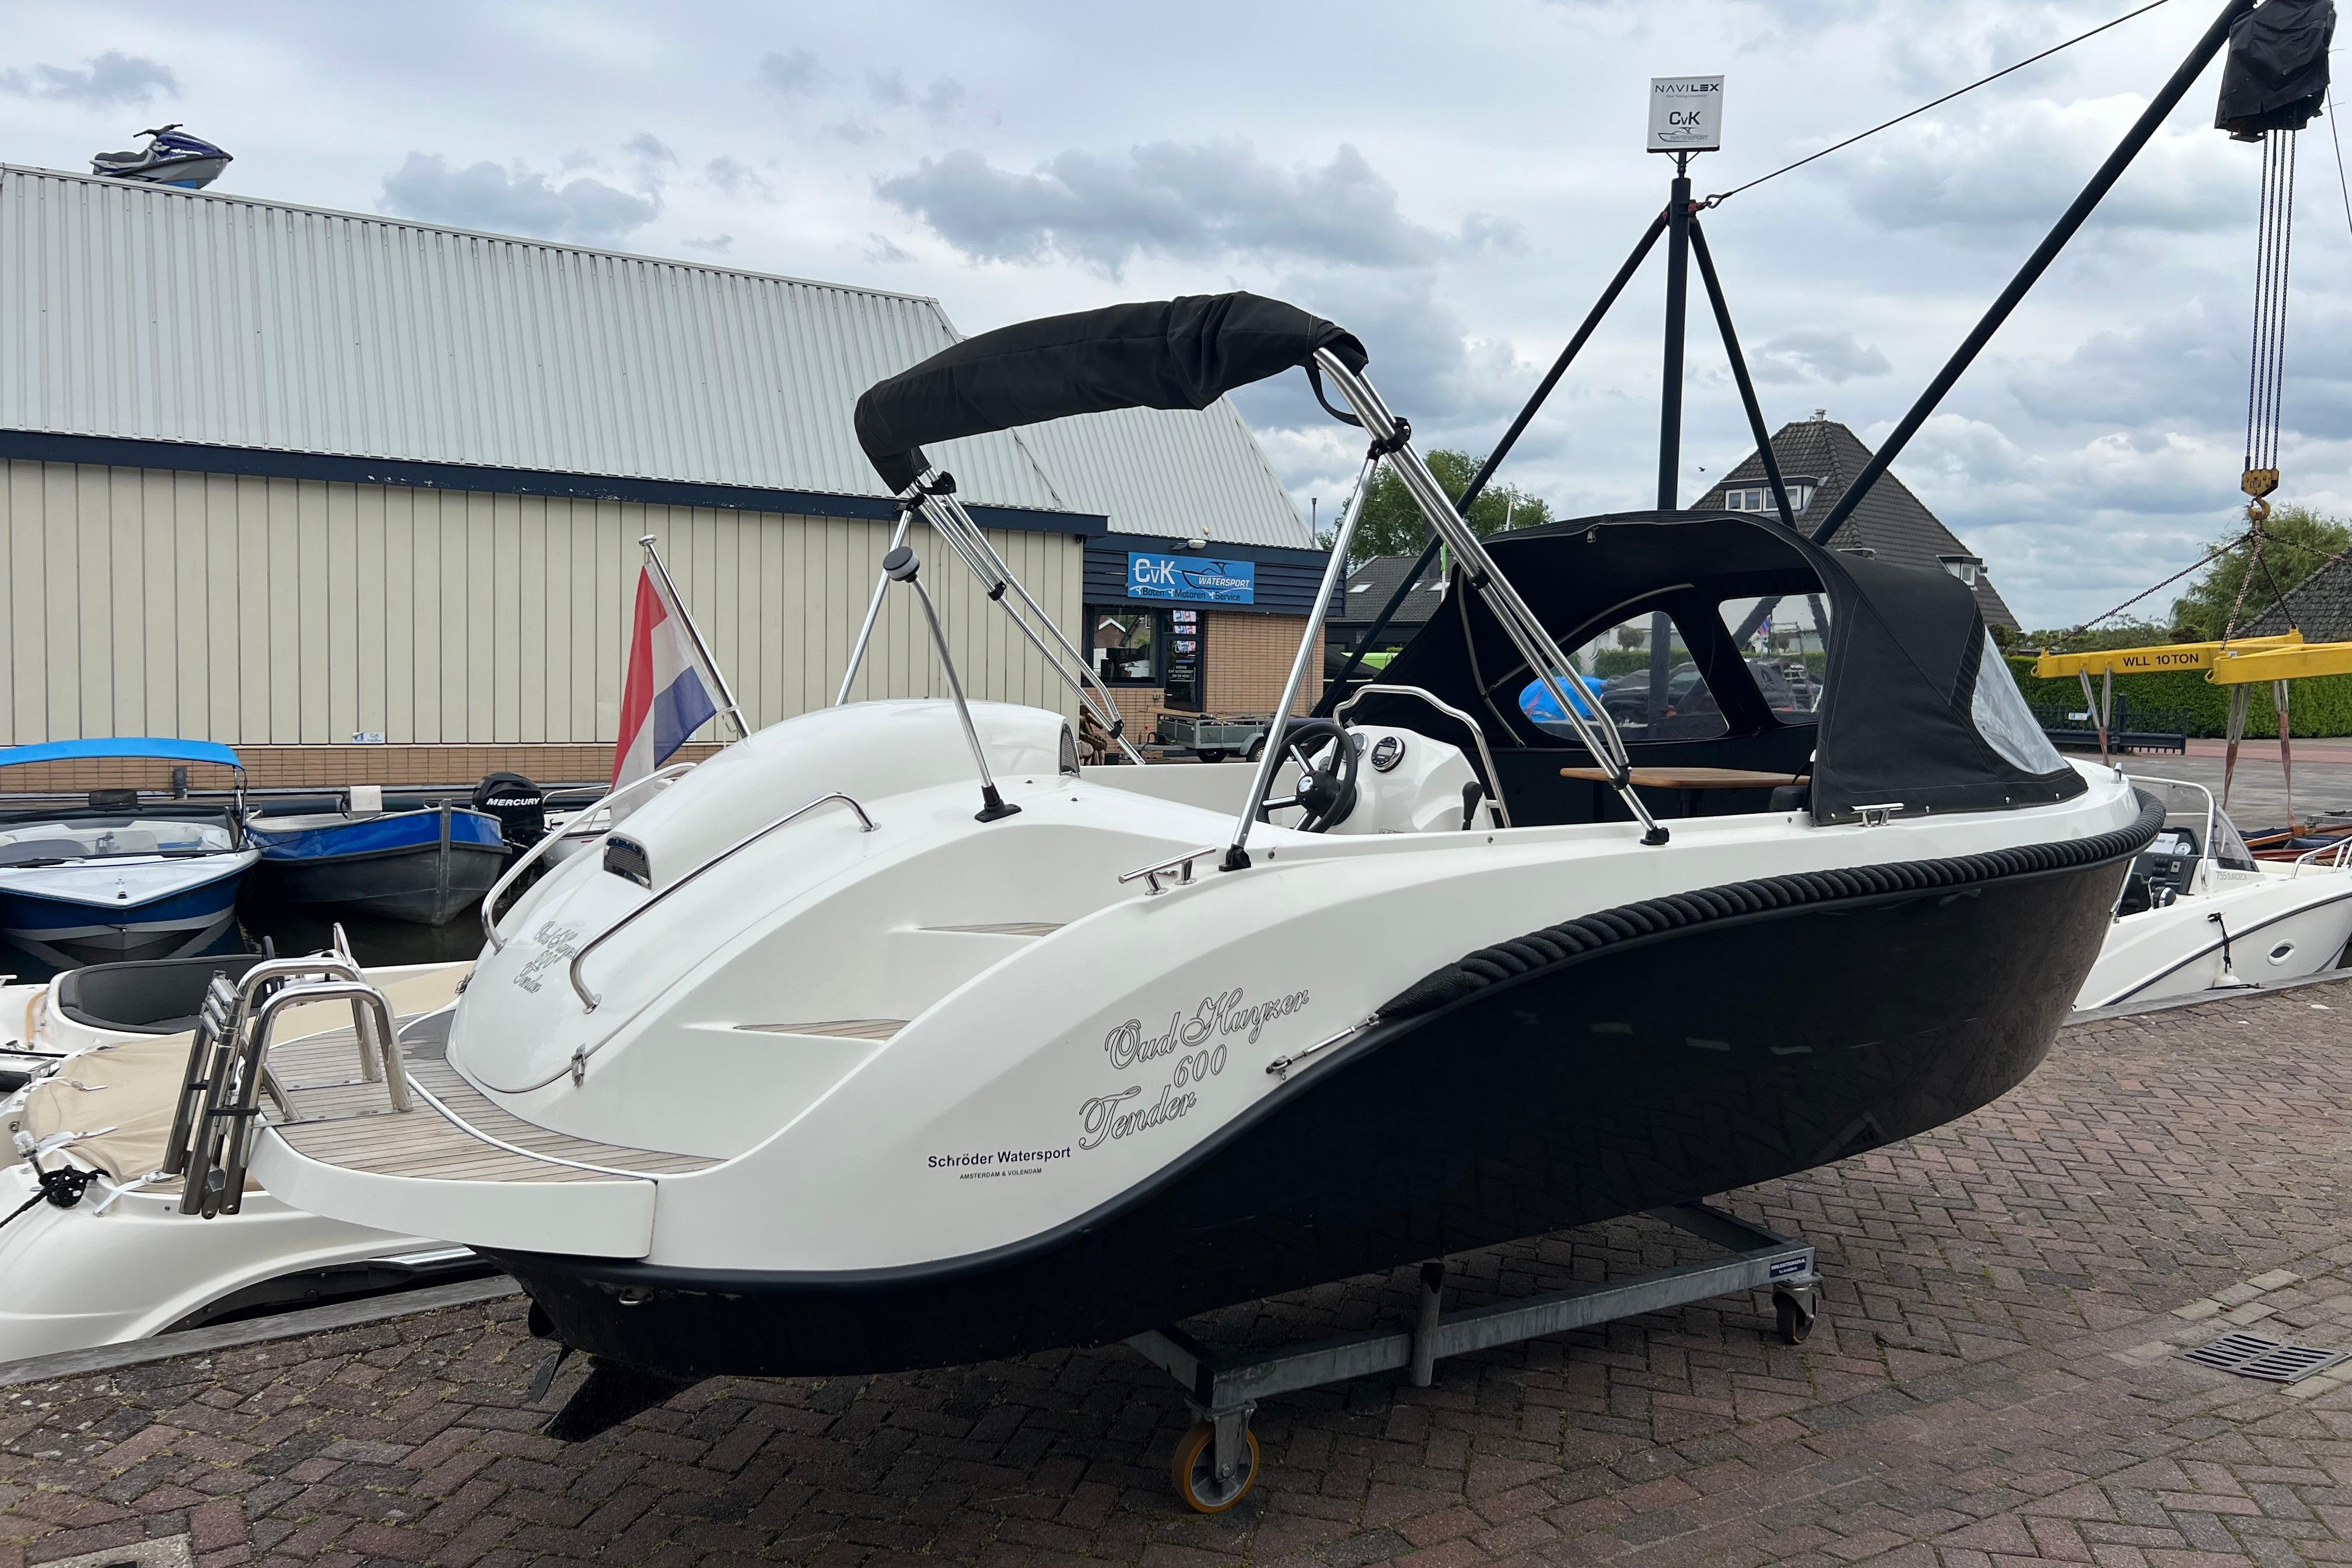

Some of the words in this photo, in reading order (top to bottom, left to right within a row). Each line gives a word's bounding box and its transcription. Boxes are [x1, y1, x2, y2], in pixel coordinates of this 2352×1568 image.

[1655, 83, 1720, 93] NAVILEX
[1199, 576, 1250, 588] WATERSPORT
[1143, 587, 1164, 597] Boten
[1175, 589, 1205, 599] Motoren
[1215, 591, 1241, 601] Service
[2123, 656, 2150, 667] WLL
[2171, 653, 2199, 664] TON
[486, 797, 540, 806] MERCURY
[1105, 1011, 1180, 1069] Oud
[1180, 988, 1309, 1046] Huyzer
[1174, 1044, 1227, 1088] 600
[1078, 1084, 1196, 1149] Tender
[928, 1153, 993, 1168] Schröder
[998, 1146, 1071, 1163] Watersport
[960, 1171, 1000, 1180] AMSTERDAM
[1008, 1168, 1042, 1176] VOLENDAM
